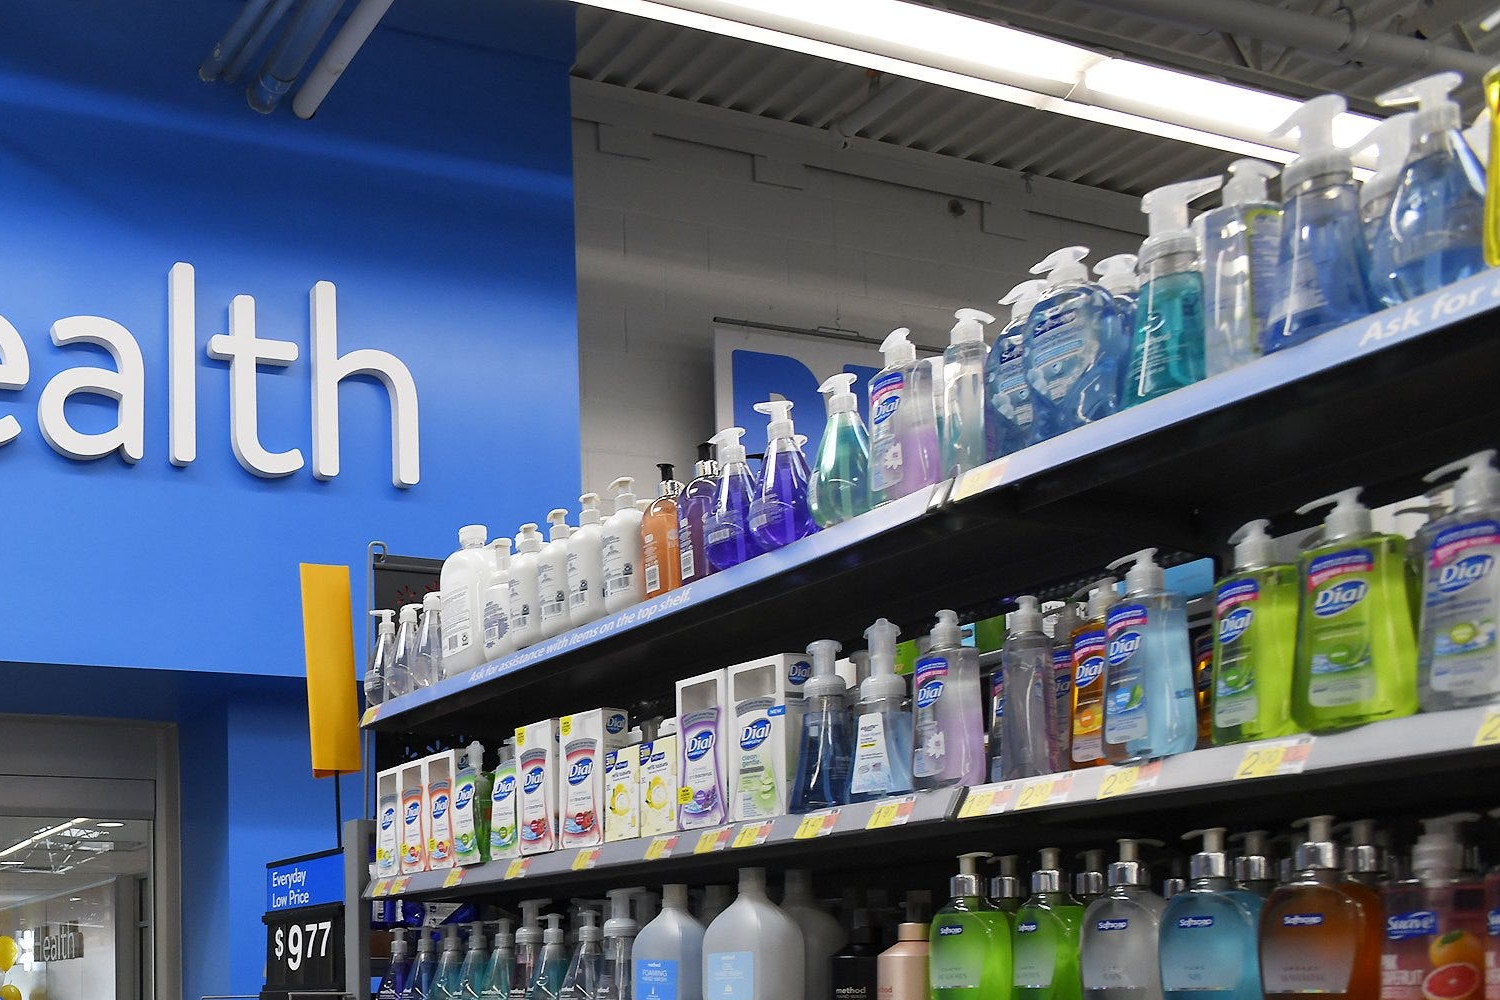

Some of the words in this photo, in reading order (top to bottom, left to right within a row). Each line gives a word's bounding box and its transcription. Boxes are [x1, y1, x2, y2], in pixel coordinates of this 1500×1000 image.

[1358, 306, 1424, 347] Ask
[1431, 285, 1487, 320] for
[1440, 558, 1493, 586] Dial
[1314, 585, 1367, 611] Dial
[1220, 613, 1253, 637] Dial
[469, 671, 484, 682] Ask
[485, 665, 499, 677] for
[499, 648, 546, 671] assistance
[546, 636, 567, 655] with
[569, 627, 598, 646] items
[599, 622, 615, 635] on
[616, 612, 636, 629] the
[637, 605, 658, 620] top
[1109, 635, 1141, 662] Dial
[918, 684, 944, 703] Dial
[742, 720, 771, 740] Dial
[569, 762, 593, 778] Dial
[272, 868, 306, 888] Everyday
[272, 893, 287, 908] Low
[289, 890, 309, 905] Price
[1098, 920, 1127, 931] Softsoap
[1179, 916, 1212, 928] Softsoap
[1387, 913, 1435, 930] Suave
[835, 987, 866, 995] method
